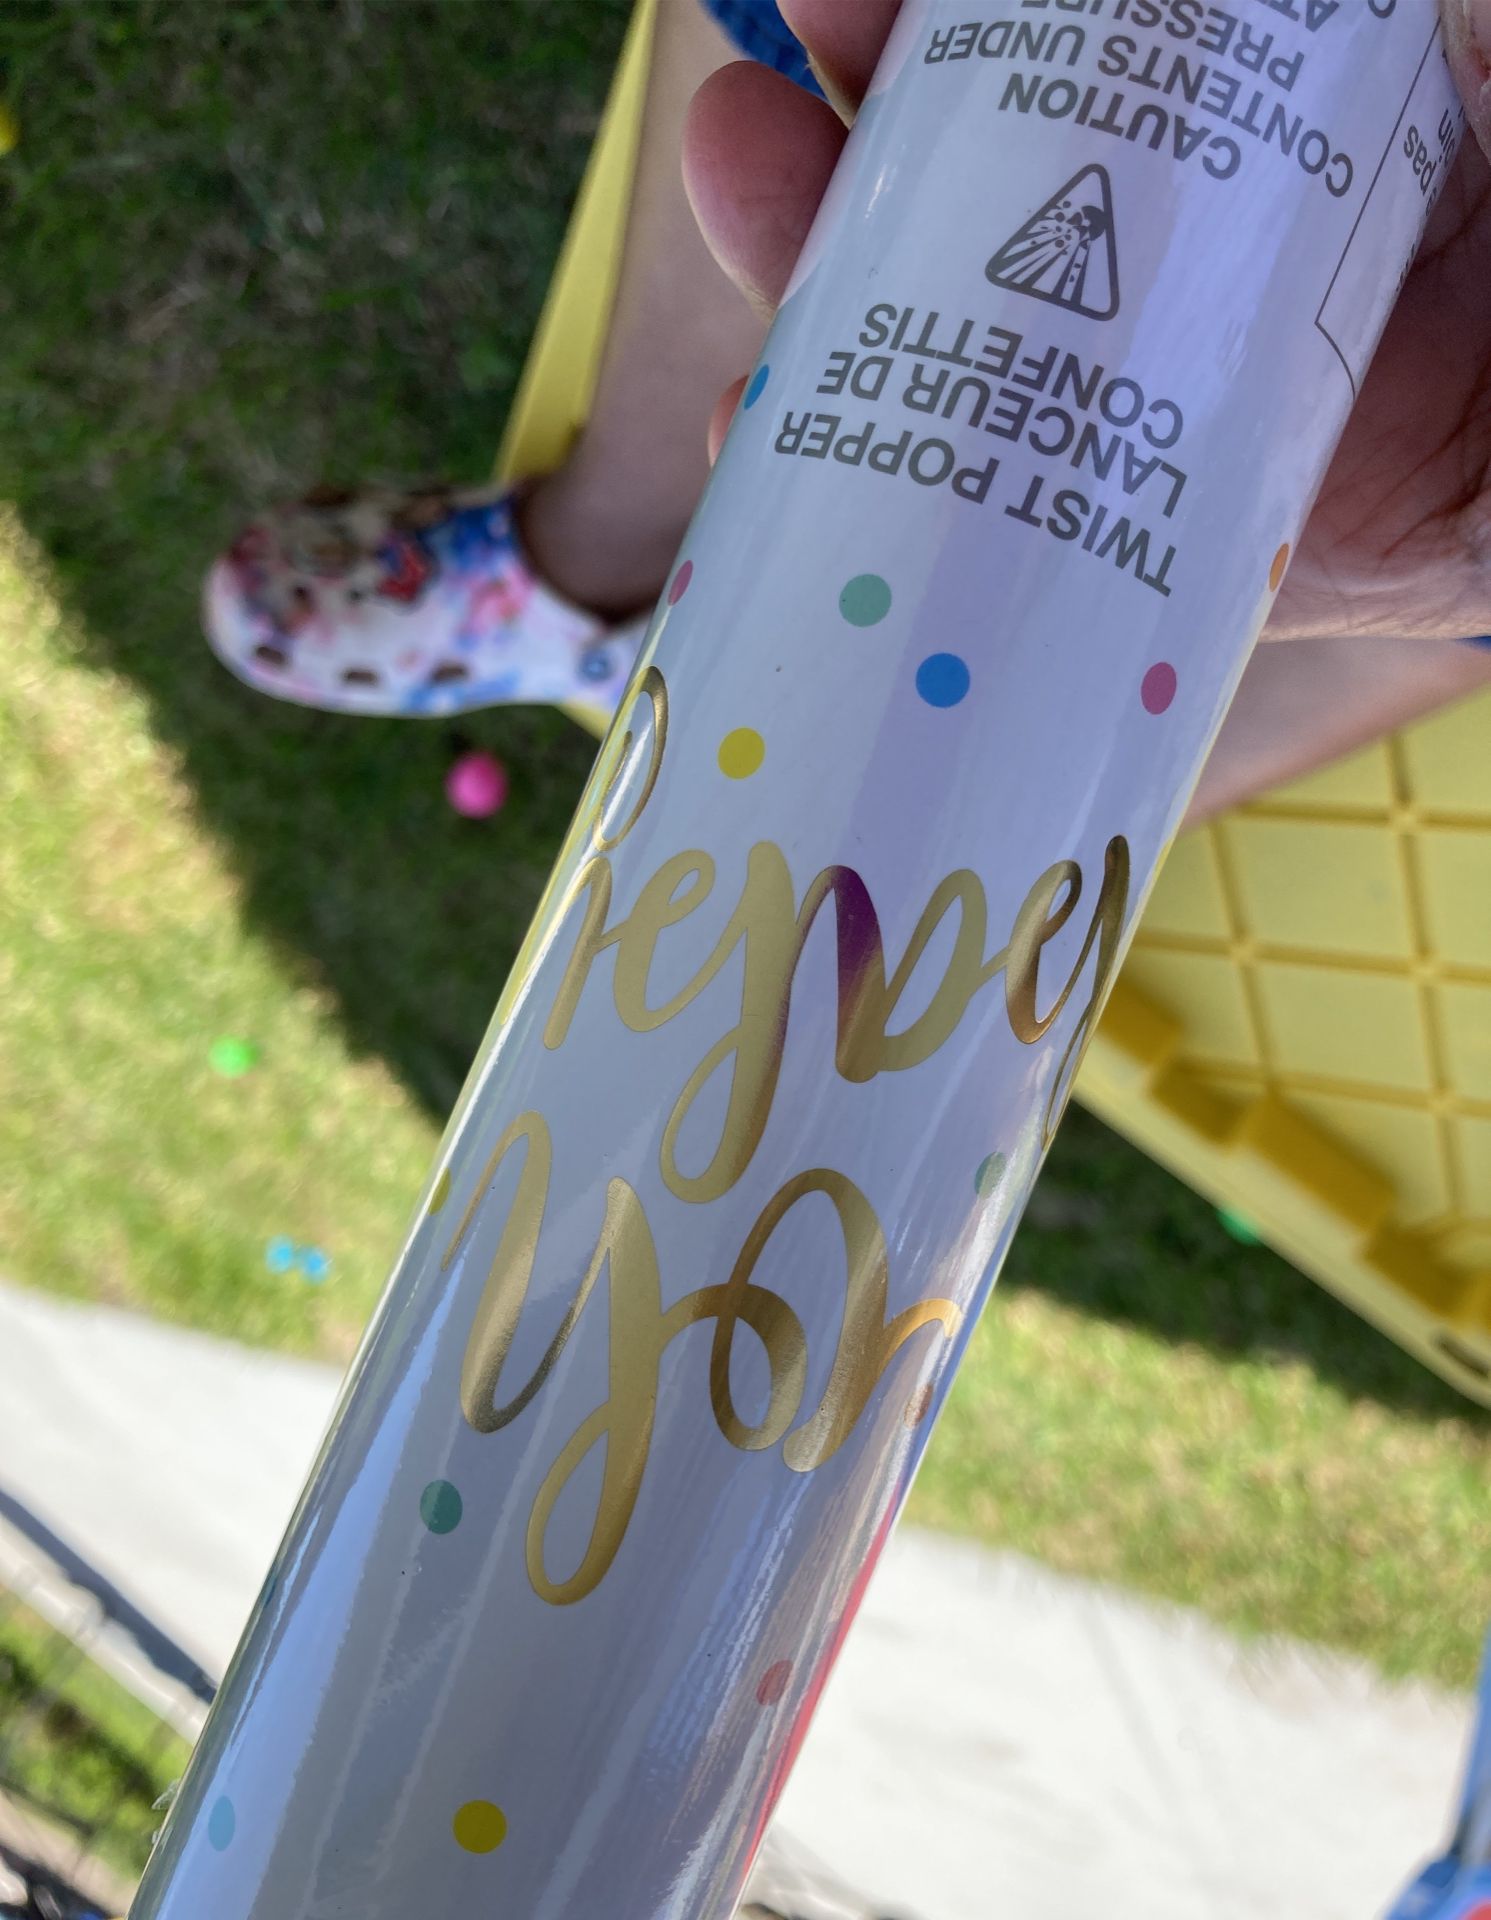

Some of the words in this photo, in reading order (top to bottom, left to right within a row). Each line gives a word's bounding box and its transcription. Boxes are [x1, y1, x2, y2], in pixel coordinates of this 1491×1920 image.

[924, 22, 1088, 65] UNDER
[1020, 0, 1305, 92] PRESS
[998, 72, 1243, 181] CAUTION
[1098, 35, 1354, 198] CONTENTS
[816, 352, 893, 401] DE
[859, 303, 1183, 449] CONFETTIS
[774, 411, 1000, 503] POPPER
[903, 364, 1188, 517] LANCEUR
[1005, 475, 1178, 597] TWIST
[441, 1110, 963, 1606] oh
